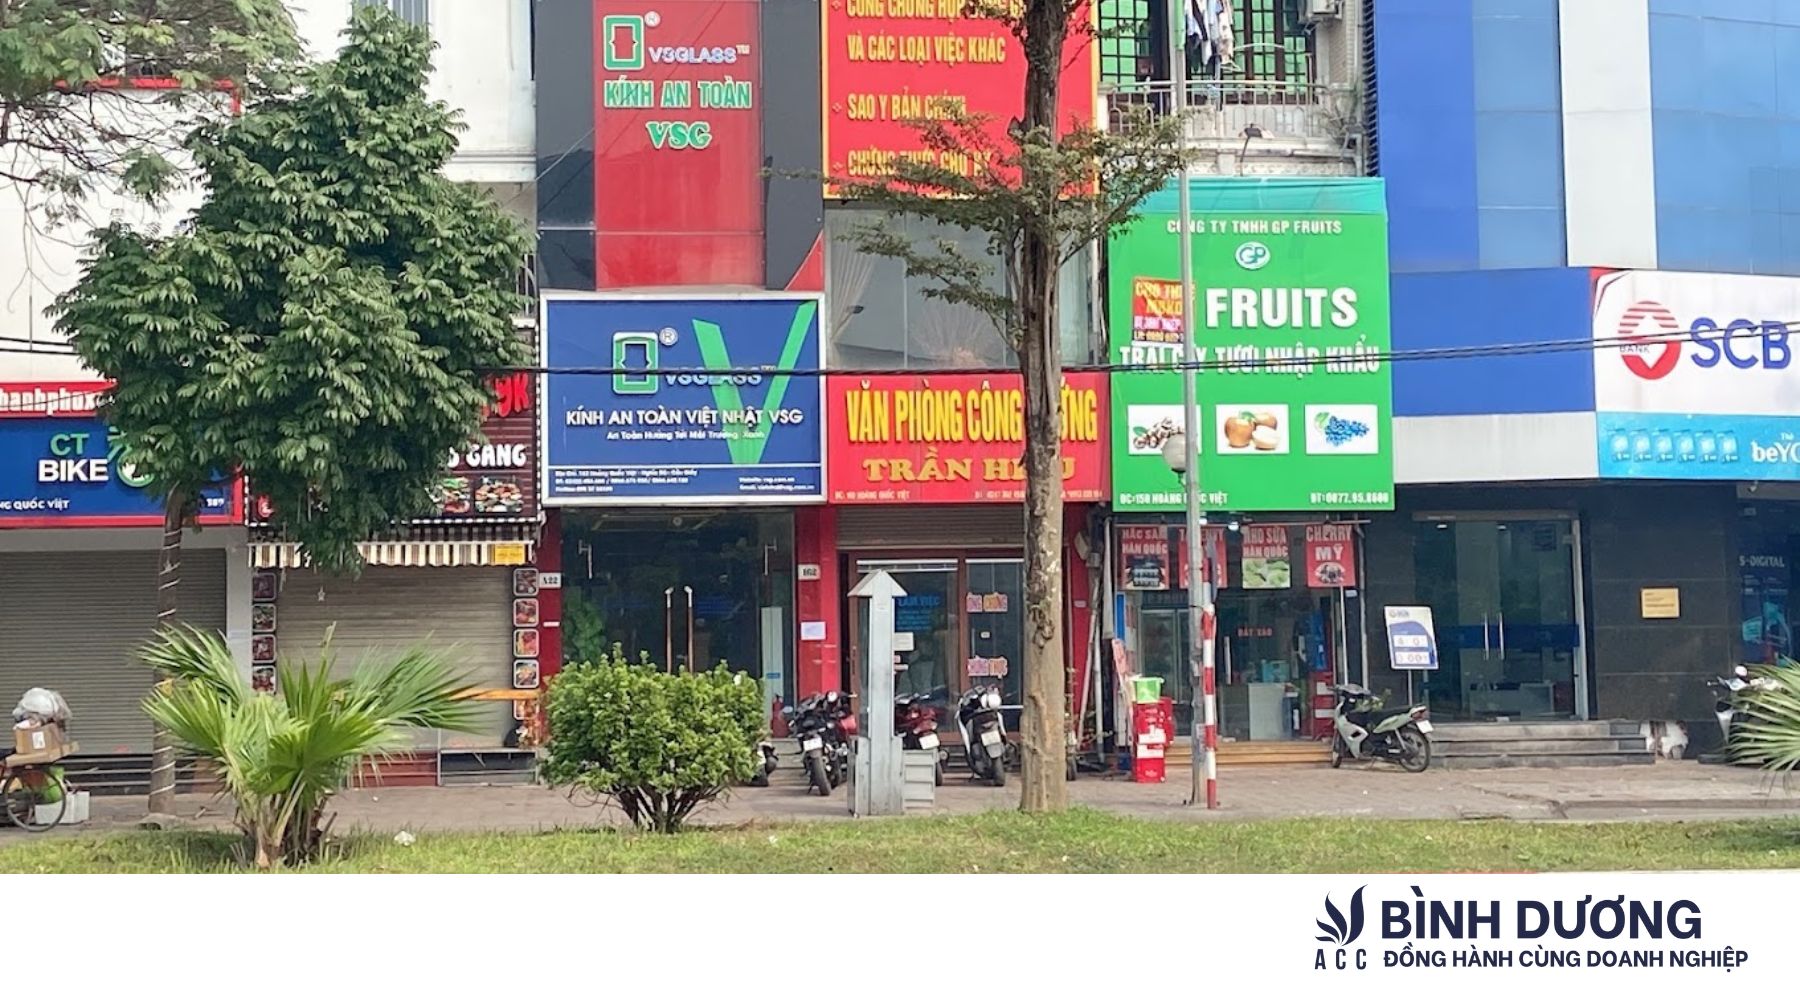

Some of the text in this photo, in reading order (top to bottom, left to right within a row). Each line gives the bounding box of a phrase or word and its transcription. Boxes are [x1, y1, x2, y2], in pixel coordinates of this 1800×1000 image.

[847, 29, 1006, 67] VÀ CÁC LOẠI VIỆC KHÁC
[604, 75, 752, 108] KÍNH AN TOÀN
[847, 92, 875, 120] SAO
[878, 93, 888, 119] Y
[891, 85, 920, 120] BẢN
[645, 121, 712, 149] VSG
[1210, 219, 1227, 234] TY
[1231, 219, 1268, 234] TNHH
[1271, 219, 1289, 234] GP
[1293, 219, 1342, 234] FRUITS
[1206, 287, 1358, 328] FRUITS
[1619, 344, 1650, 353] BANK
[1689, 317, 1792, 370] SCB
[1170, 345, 1208, 375] CY
[566, 405, 804, 429] KÍNH AN TOÀN VIỆT NHẬT VSG
[846, 380, 890, 442] VĂN
[895, 379, 964, 442] PHÒNG
[967, 380, 1023, 442] CÔNG
[50, 432, 90, 456] CT
[38, 458, 109, 483] BIKE
[862, 446, 973, 482] TRẦN
[13, 497, 45, 511] QUỐC
[1209, 491, 1228, 506] VIỆT
[1305, 524, 1353, 542] CHERRY
[1739, 555, 1785, 567] S-DIGITAL
